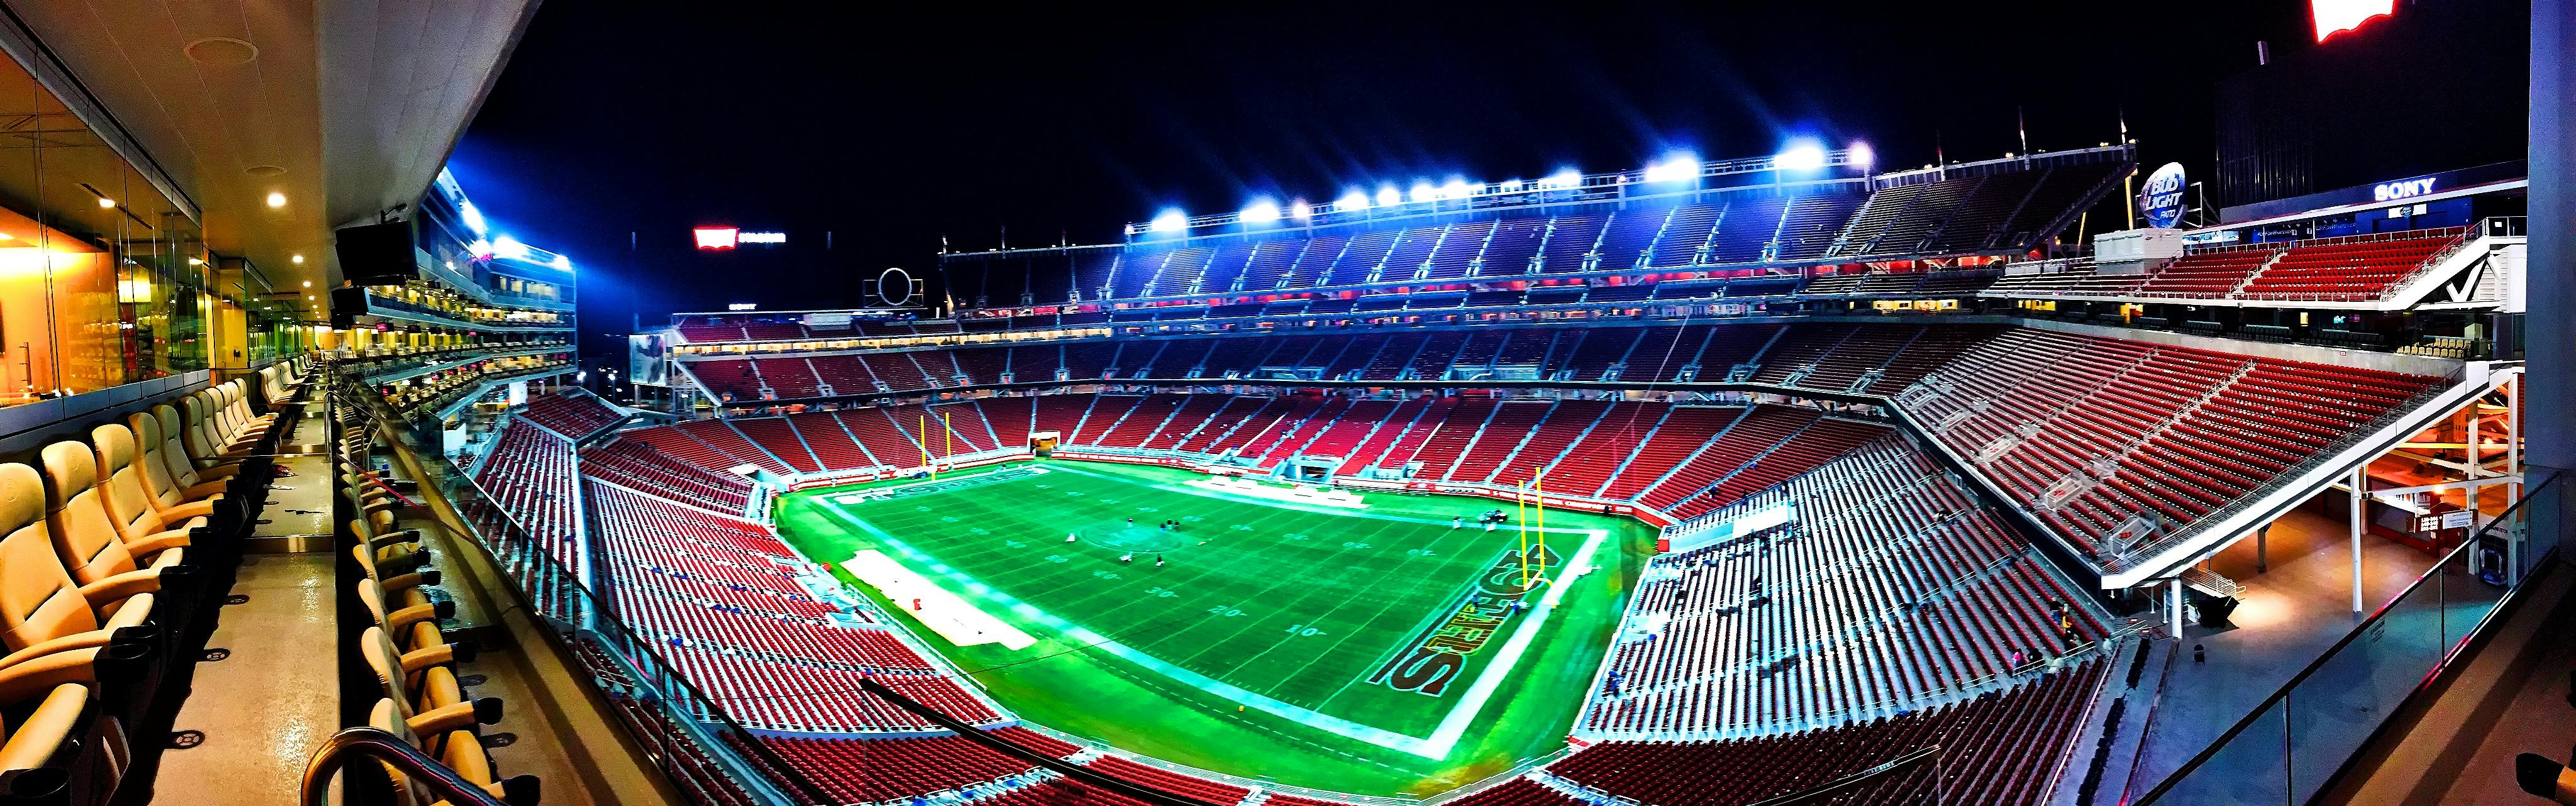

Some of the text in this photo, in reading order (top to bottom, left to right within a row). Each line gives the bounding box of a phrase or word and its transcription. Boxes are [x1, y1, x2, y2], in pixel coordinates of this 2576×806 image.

[2150, 177, 2179, 196] BUD
[2374, 177, 2436, 201] SONY
[2144, 192, 2183, 211] LIGHT
[1208, 605, 1241, 617] 20
[1285, 624, 1319, 636] 10
